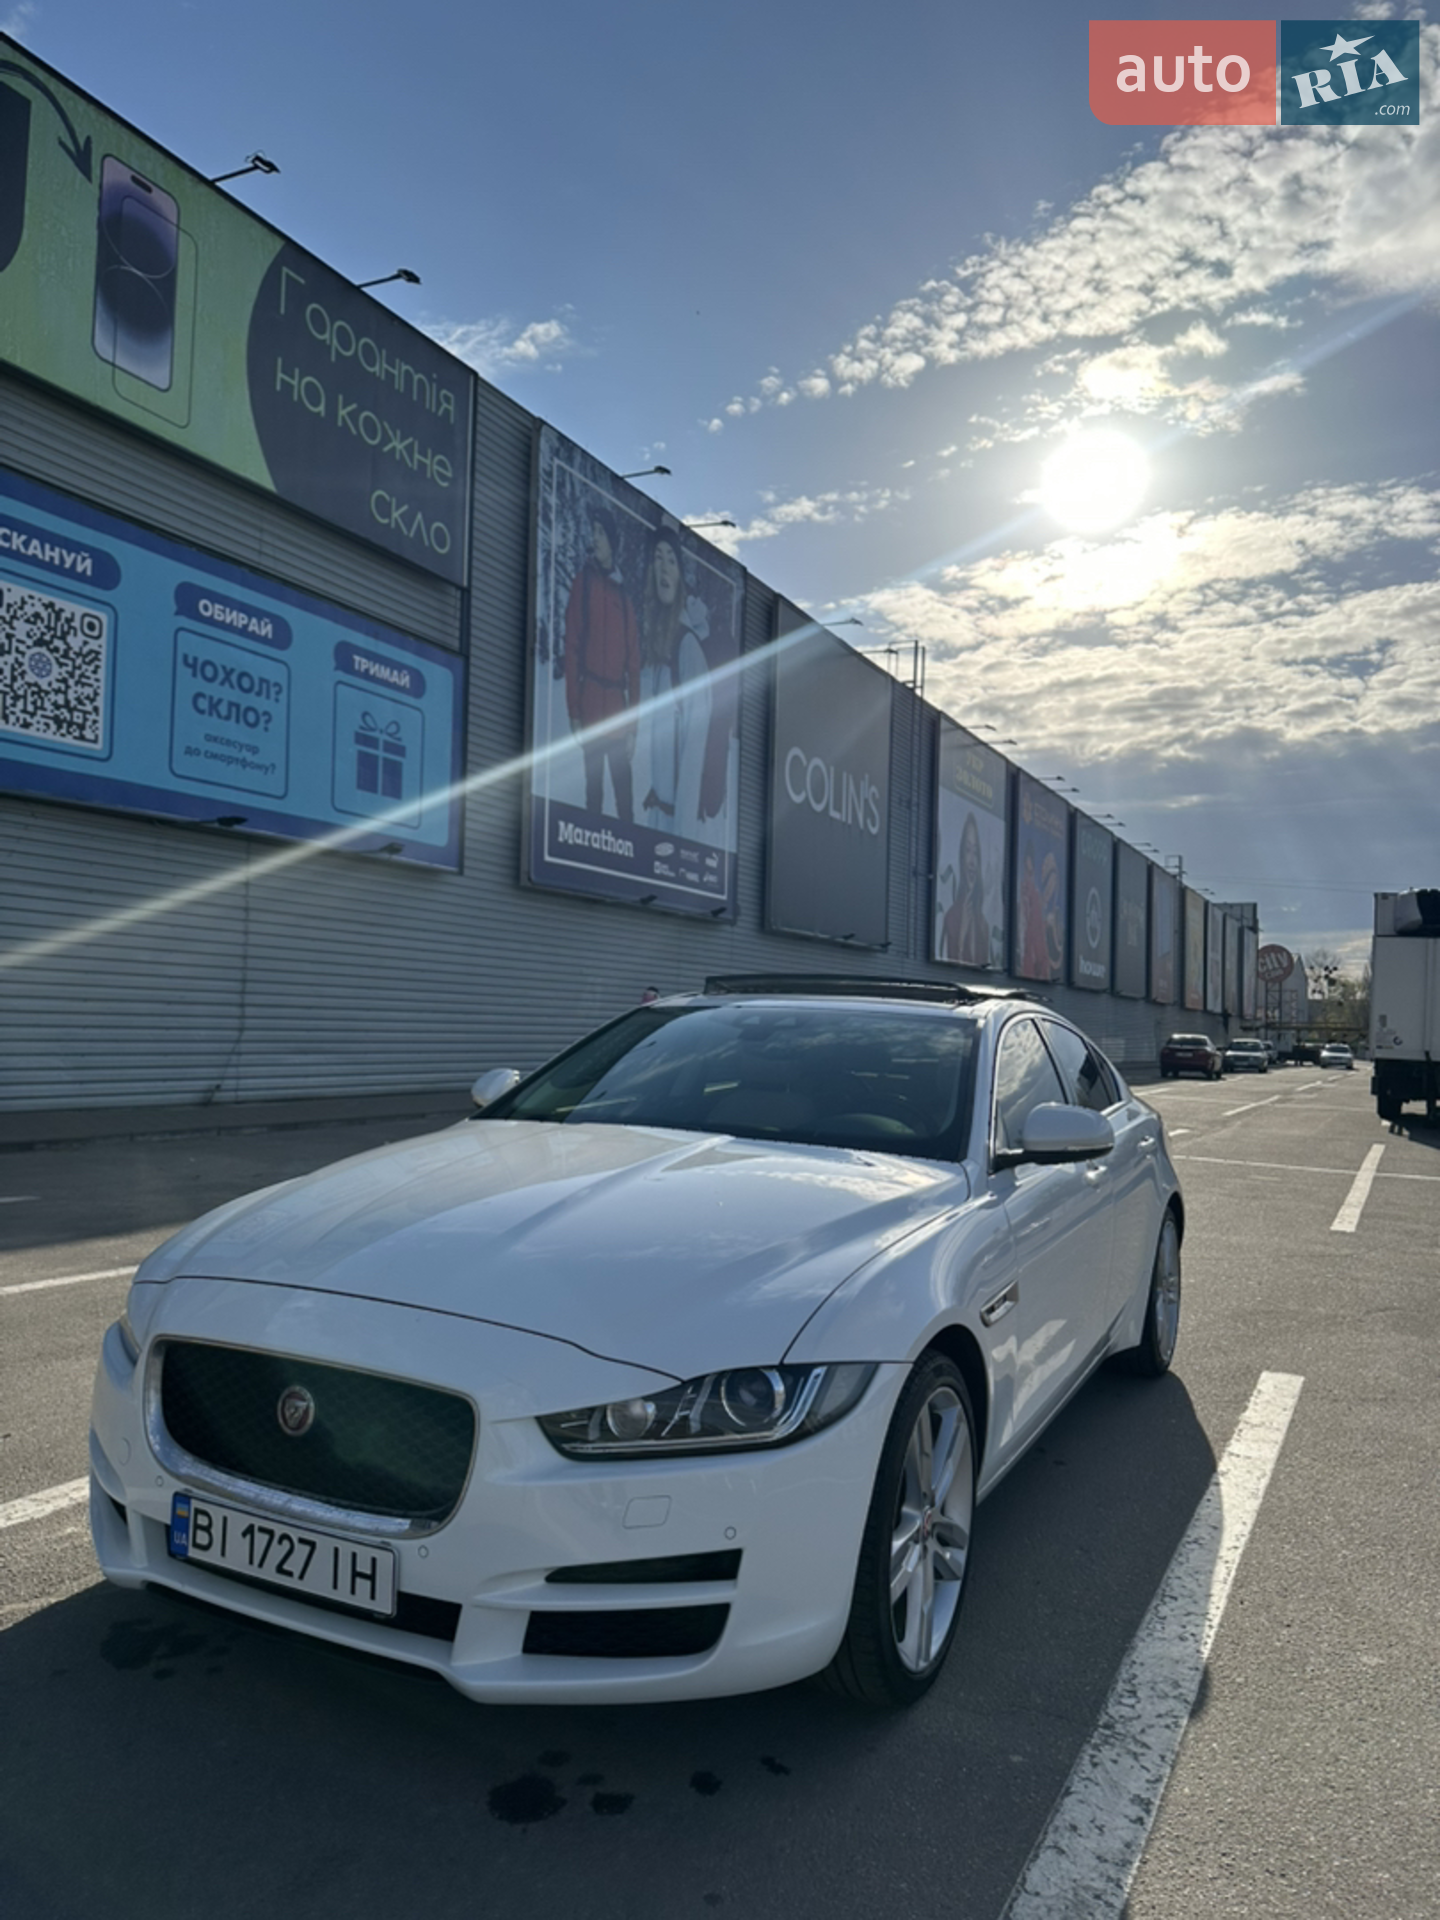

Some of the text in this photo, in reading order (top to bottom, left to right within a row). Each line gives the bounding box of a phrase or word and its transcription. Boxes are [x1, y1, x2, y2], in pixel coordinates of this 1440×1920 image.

[280, 265, 456, 425] Гарантія
[276, 357, 454, 487] на кожне
[0, 527, 93, 577] СКАНУЙ
[198, 598, 273, 640] ОБИРАЙ
[182, 652, 283, 704] ЧОХОЛ?
[352, 654, 411, 690] ТРИМАЙ
[191, 691, 273, 733] СКЛО?
[184, 745, 277, 776] до смартфону?
[204, 733, 260, 756] аксесуар
[785, 746, 880, 836] COLIN'S
[558, 820, 634, 858] Marathon
[174, 1531, 188, 1548] UA
[191, 1507, 378, 1601] BI 1727 IH
